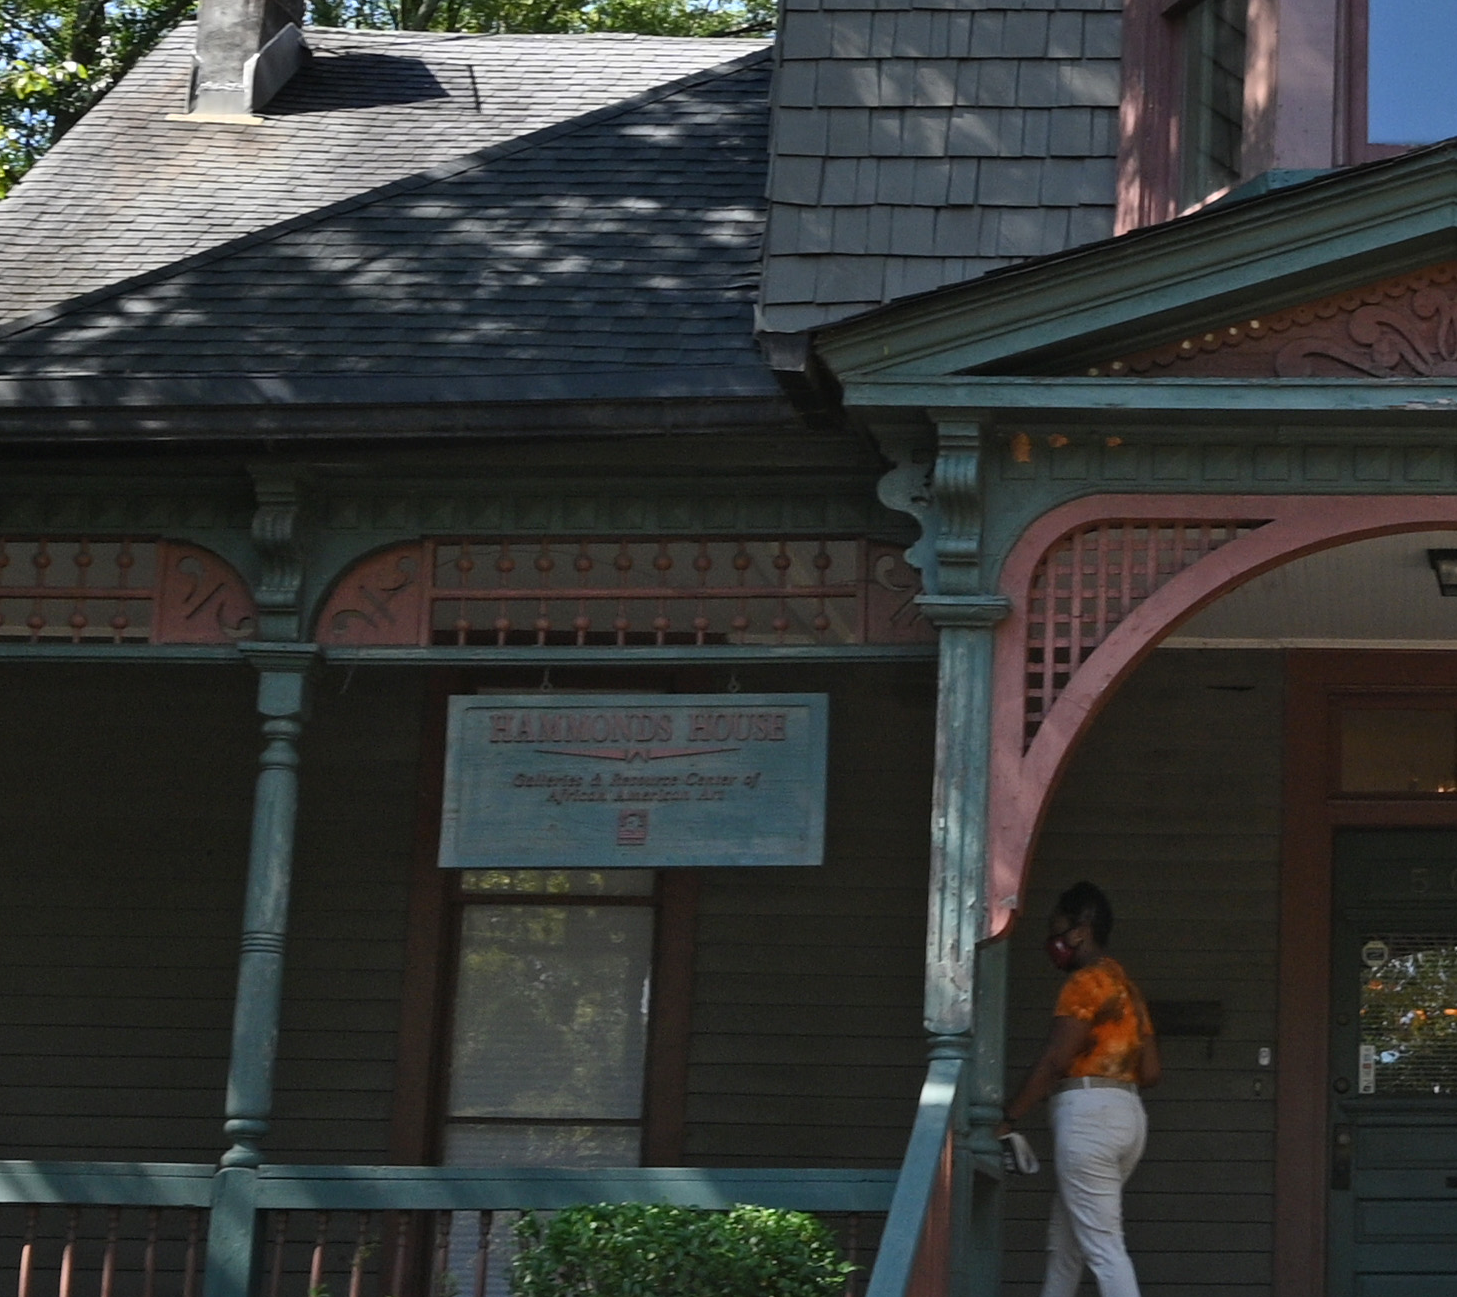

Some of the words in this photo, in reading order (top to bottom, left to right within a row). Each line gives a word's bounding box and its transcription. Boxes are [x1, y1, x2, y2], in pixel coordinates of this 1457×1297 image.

[488, 713, 673, 743] HAMMONDS
[688, 713, 788, 742] HOUSE
[513, 773, 584, 787] Galleries
[610, 773, 679, 786] Resource
[685, 773, 738, 786] Center
[742, 772, 762, 788] of
[546, 789, 607, 804] African
[614, 789, 692, 803] American
[697, 789, 725, 801] Art
